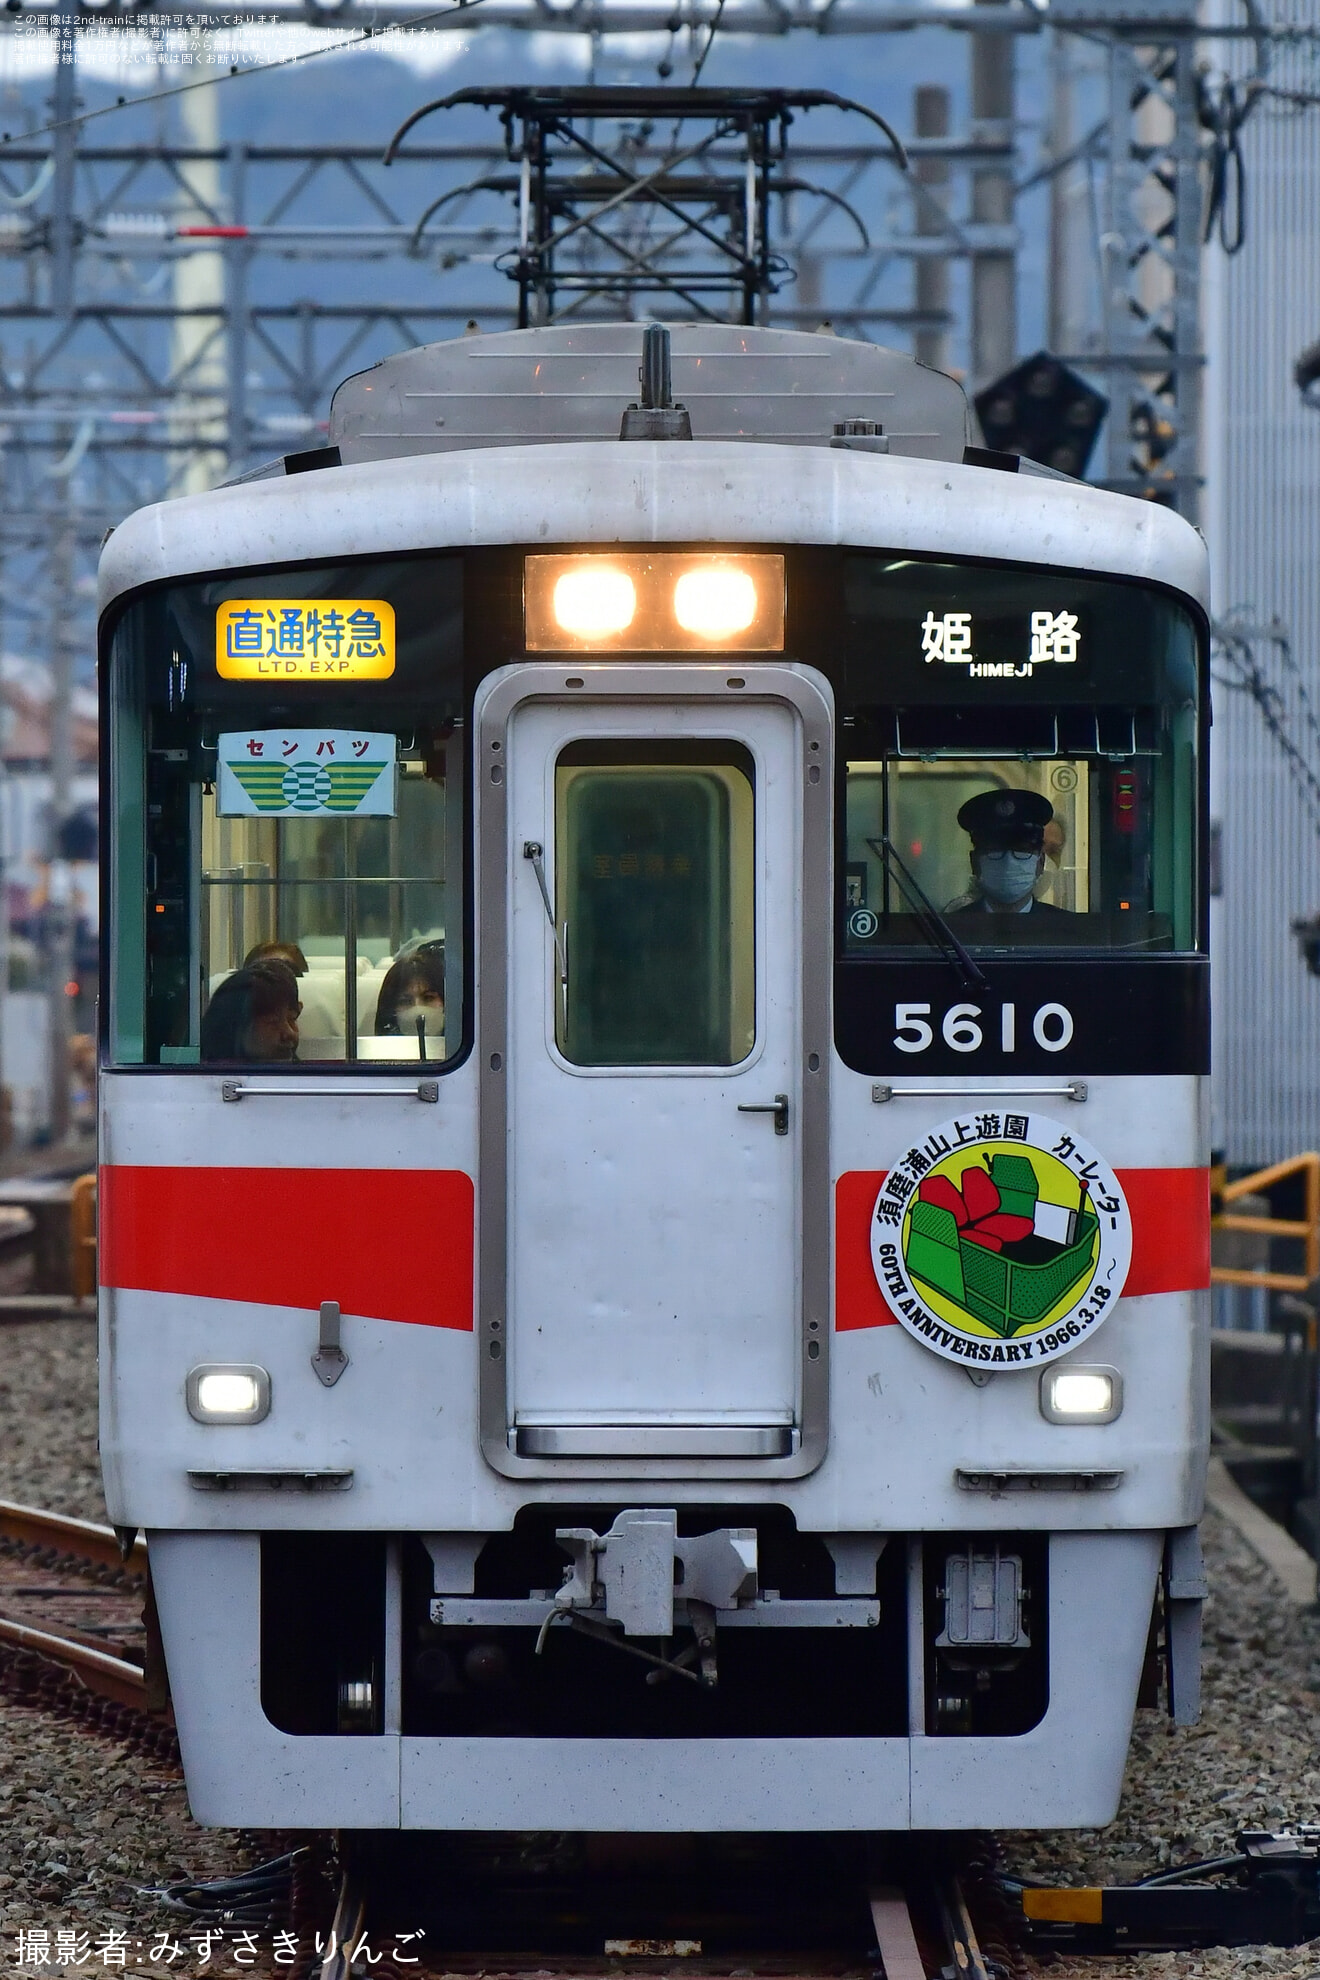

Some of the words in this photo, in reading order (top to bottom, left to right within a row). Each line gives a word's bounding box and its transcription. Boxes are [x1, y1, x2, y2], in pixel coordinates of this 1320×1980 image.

[227, 608, 386, 657] 直通特急
[921, 610, 1081, 663] 姫路
[258, 661, 303, 673] LTD.
[310, 661, 355, 673] EXP.
[969, 663, 1033, 677] HIMEJI
[246, 738, 370, 757] センバツ
[893, 1003, 1074, 1053] 5610
[877, 1114, 1029, 1227] 須磨浦山上遊園
[1052, 1135, 1120, 1230] カーレーター
[879, 1243, 907, 1298] 60TH
[898, 1298, 1034, 1363] ANNIVERSARY
